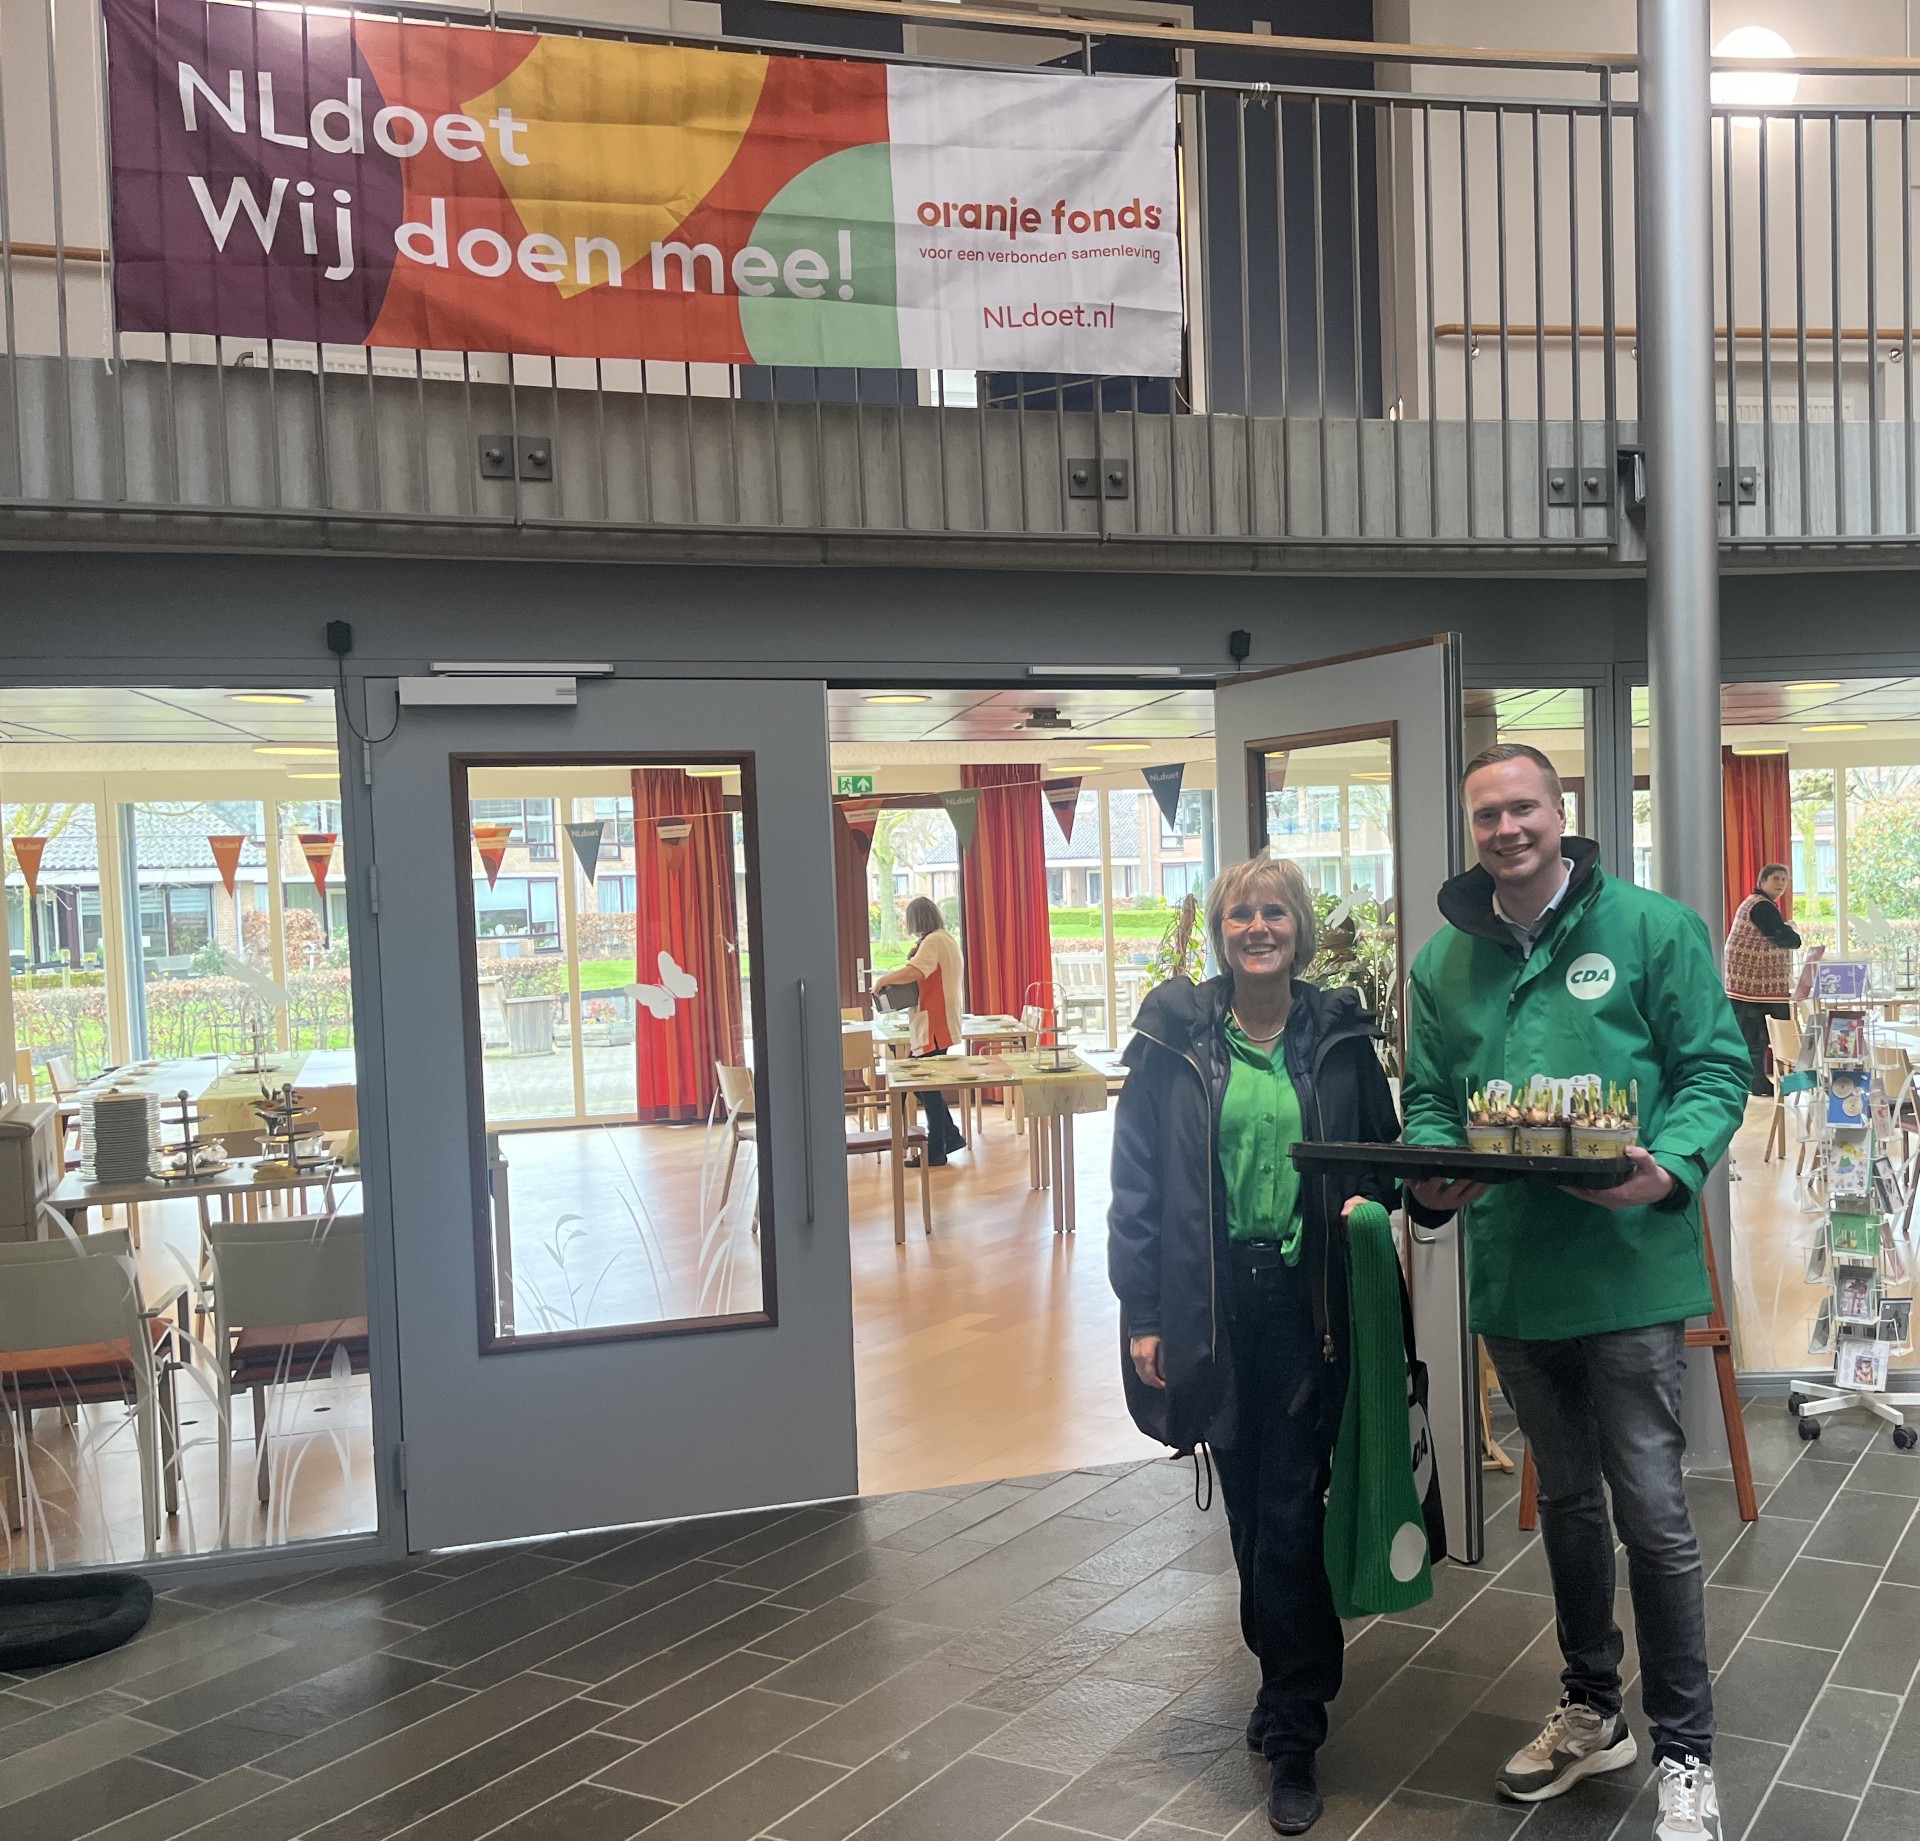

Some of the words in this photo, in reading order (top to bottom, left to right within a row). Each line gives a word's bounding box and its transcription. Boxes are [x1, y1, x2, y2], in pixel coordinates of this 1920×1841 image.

[178, 61, 531, 167] NLdoet
[916, 196, 1042, 240] oranje
[1051, 197, 1162, 236] fonds
[187, 175, 355, 282] Wij
[394, 197, 622, 288] doen
[651, 229, 855, 301] mee!
[919, 247, 954, 262] voor
[957, 248, 985, 263] een
[987, 247, 1067, 264] verbonden
[1071, 244, 1161, 264] samenleving
[983, 302, 1115, 330] NLdoet.nl
[1150, 771, 1179, 782] NLdoet
[946, 796, 975, 806] NLdoet
[572, 829, 599, 838] NLdoet
[1570, 969, 1609, 984] CDA
[1412, 1427, 1428, 1473] DA
